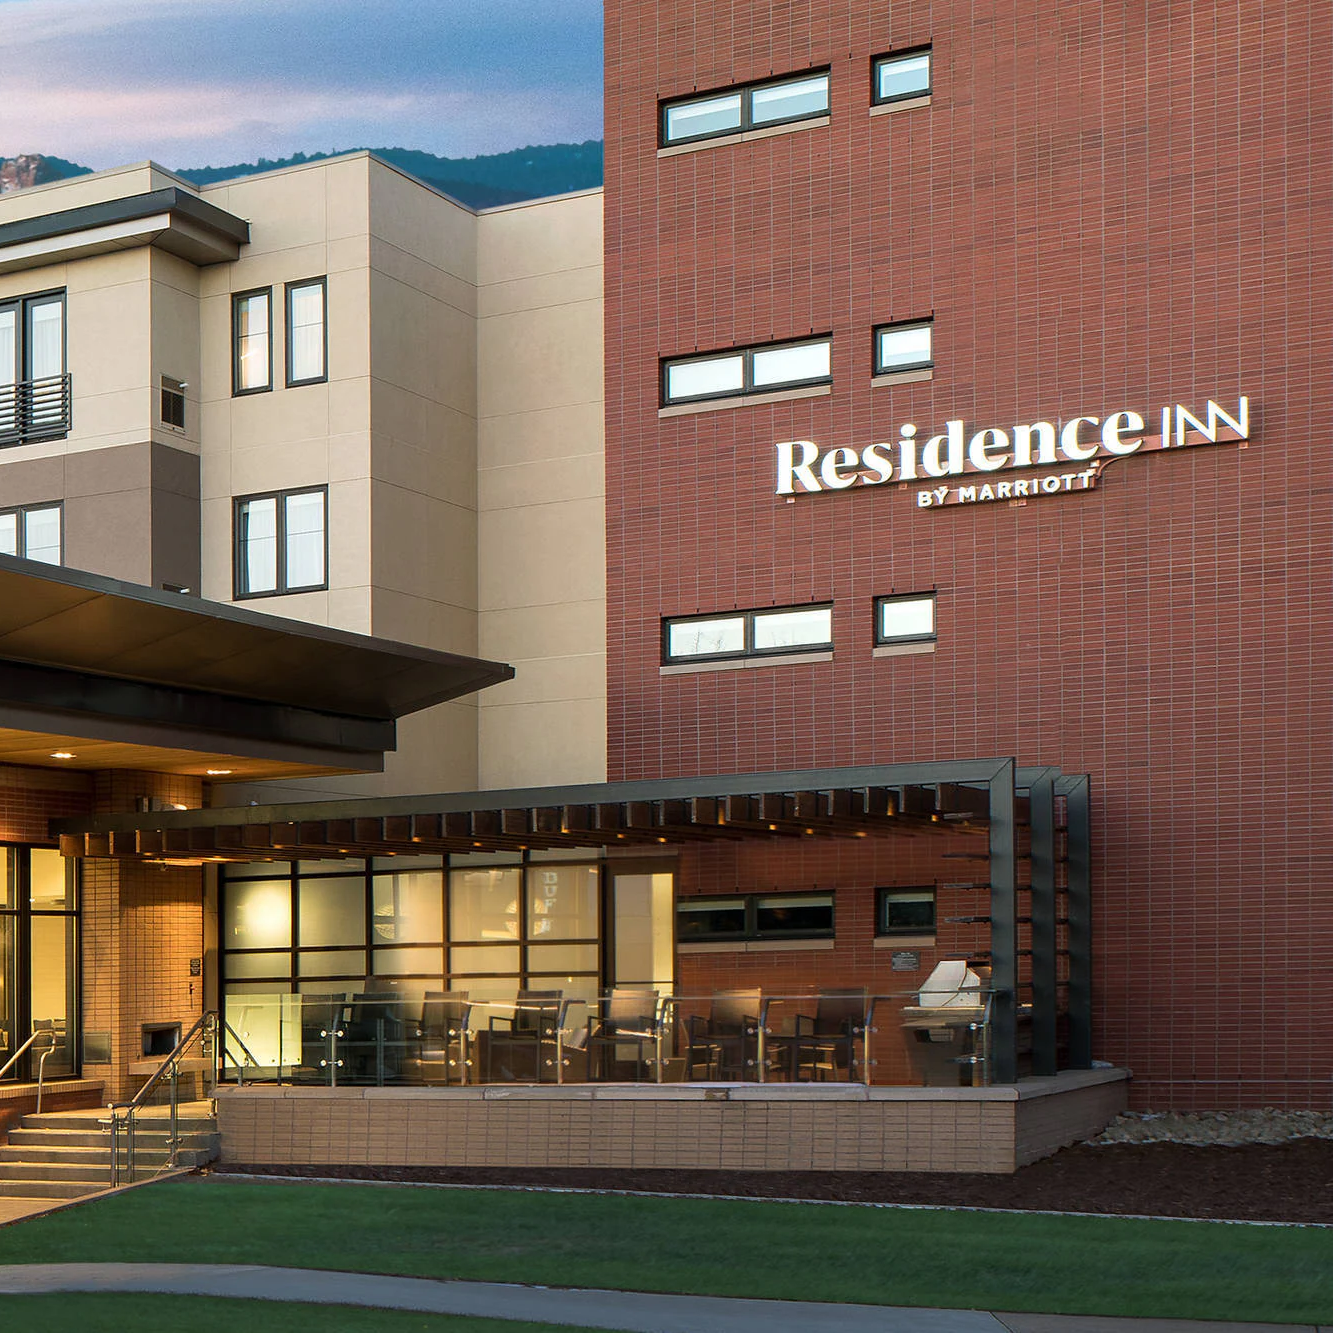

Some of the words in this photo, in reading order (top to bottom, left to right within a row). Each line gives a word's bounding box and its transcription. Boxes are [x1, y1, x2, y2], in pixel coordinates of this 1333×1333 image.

[775, 410, 1145, 495] Residence
[1161, 396, 1249, 449] INN
[917, 486, 948, 508] BY
[958, 469, 1096, 503] MARRIOTT
